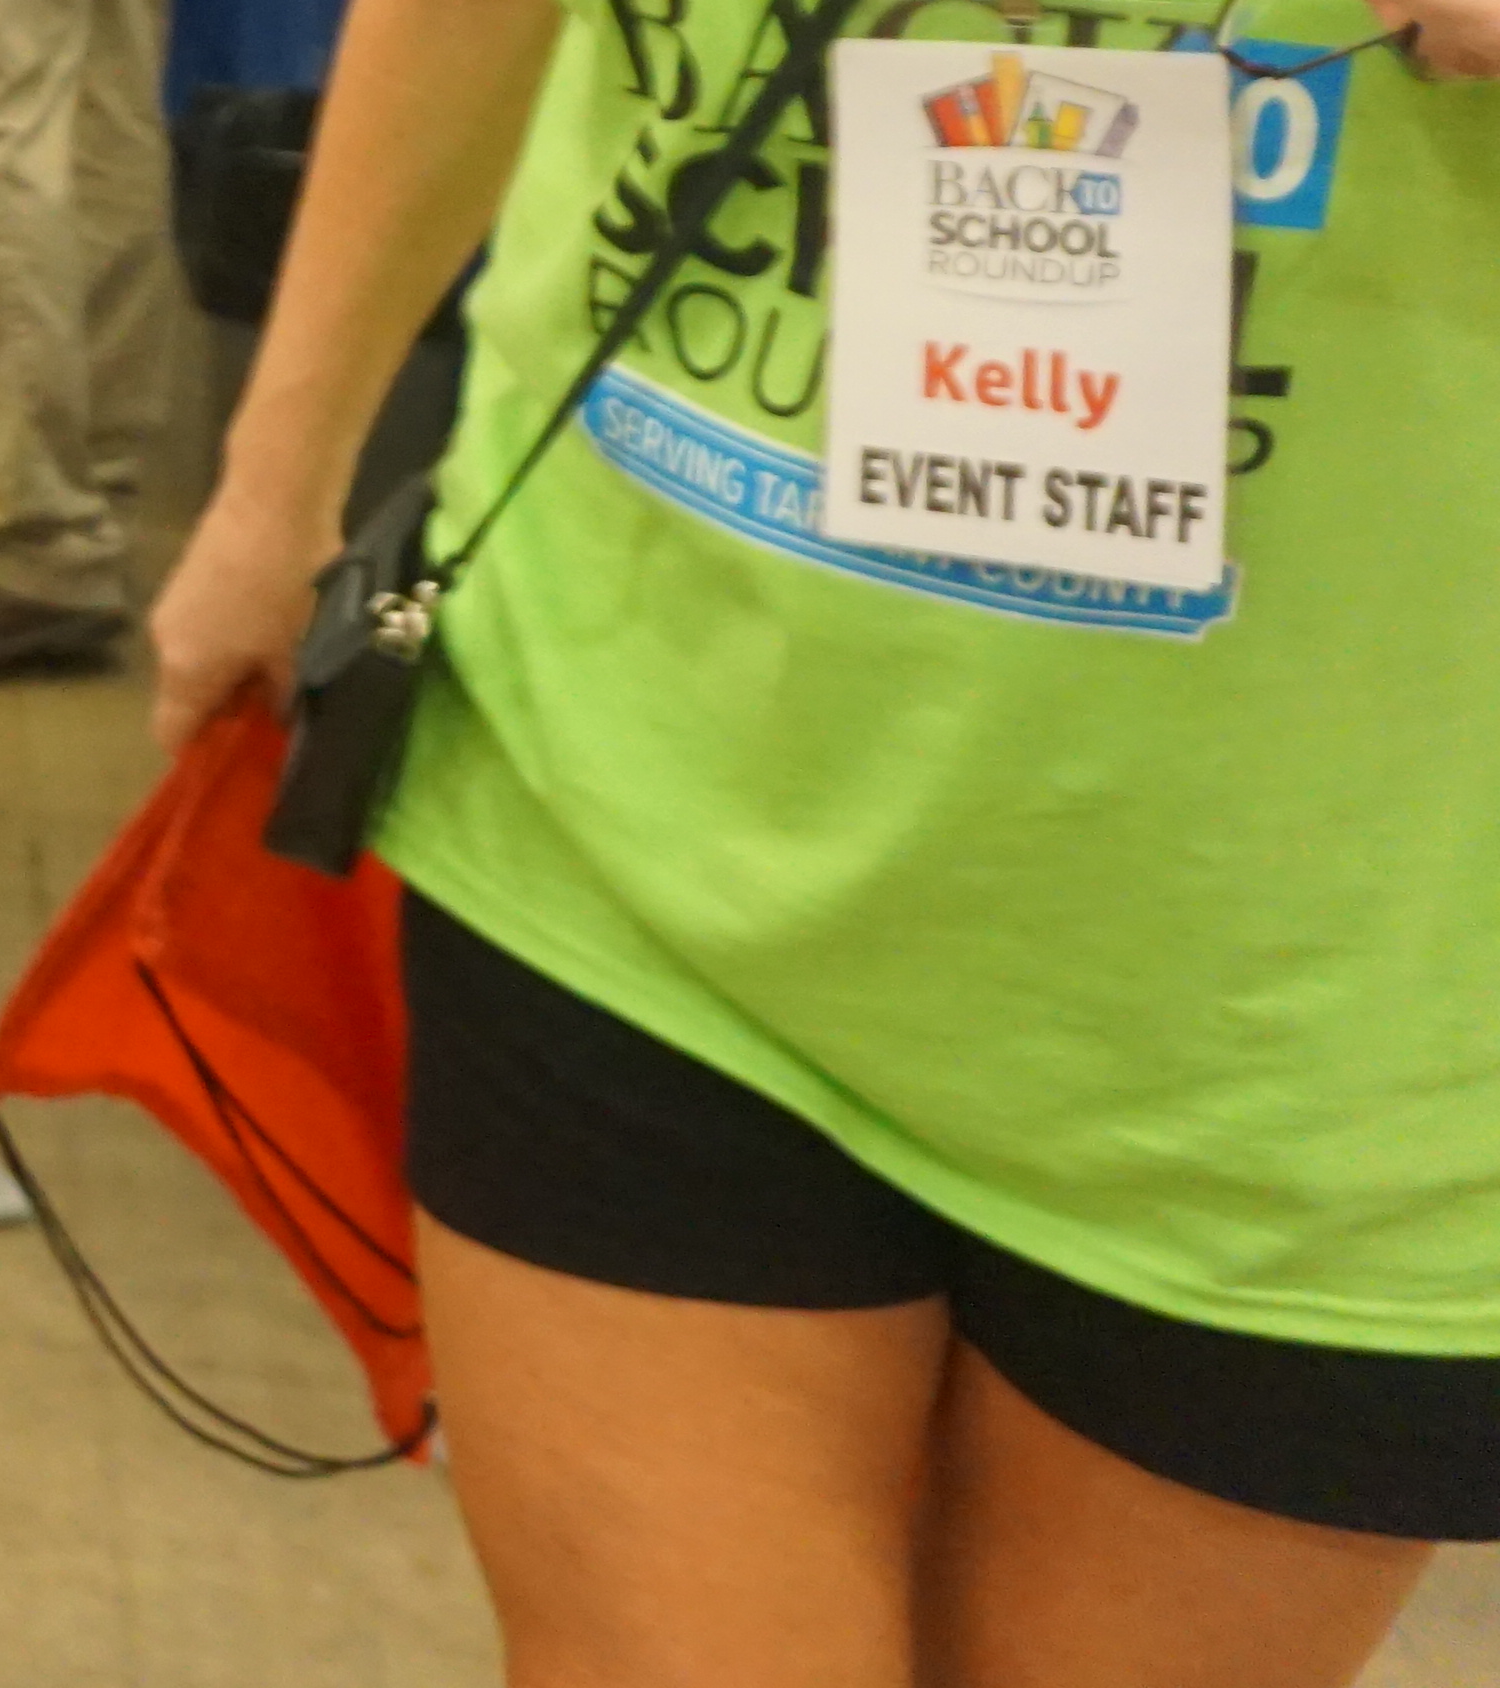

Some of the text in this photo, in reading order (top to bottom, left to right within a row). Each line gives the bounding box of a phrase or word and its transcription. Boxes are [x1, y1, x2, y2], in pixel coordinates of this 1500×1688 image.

[928, 159, 1119, 214] BACK TO
[929, 210, 1120, 259] SCHOOL
[928, 249, 1122, 287] ROUNDUP
[922, 339, 1122, 430] Kelly
[858, 445, 1027, 521] EVENT
[1043, 465, 1208, 544] STAFF
